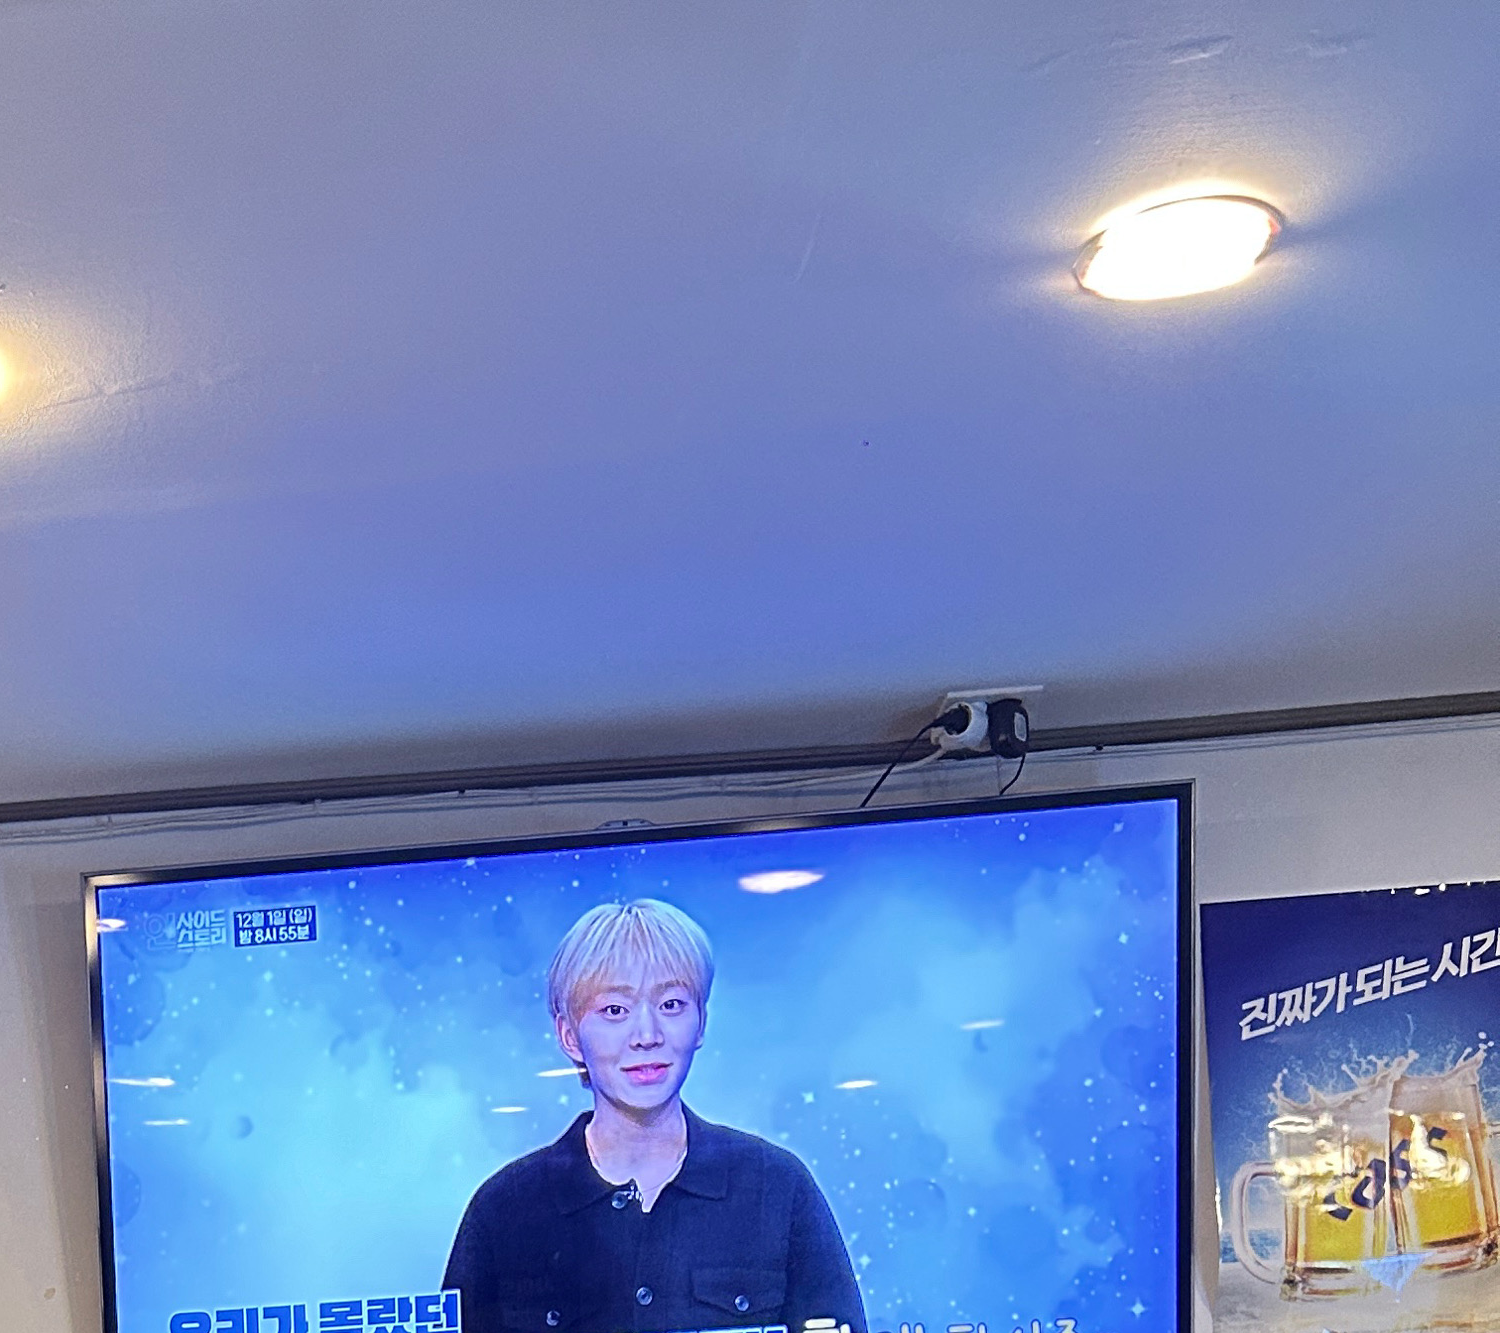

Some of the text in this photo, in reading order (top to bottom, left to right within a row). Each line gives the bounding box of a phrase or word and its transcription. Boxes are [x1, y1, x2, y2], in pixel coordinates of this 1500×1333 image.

[177, 909, 225, 929] 사이드
[237, 907, 313, 928] 12월 1일 (일)
[177, 927, 227, 948] 스토리
[240, 926, 309, 945] 밤 8시 55분
[1239, 972, 1352, 1041] 진짜가
[1353, 956, 1430, 1006] 되는
